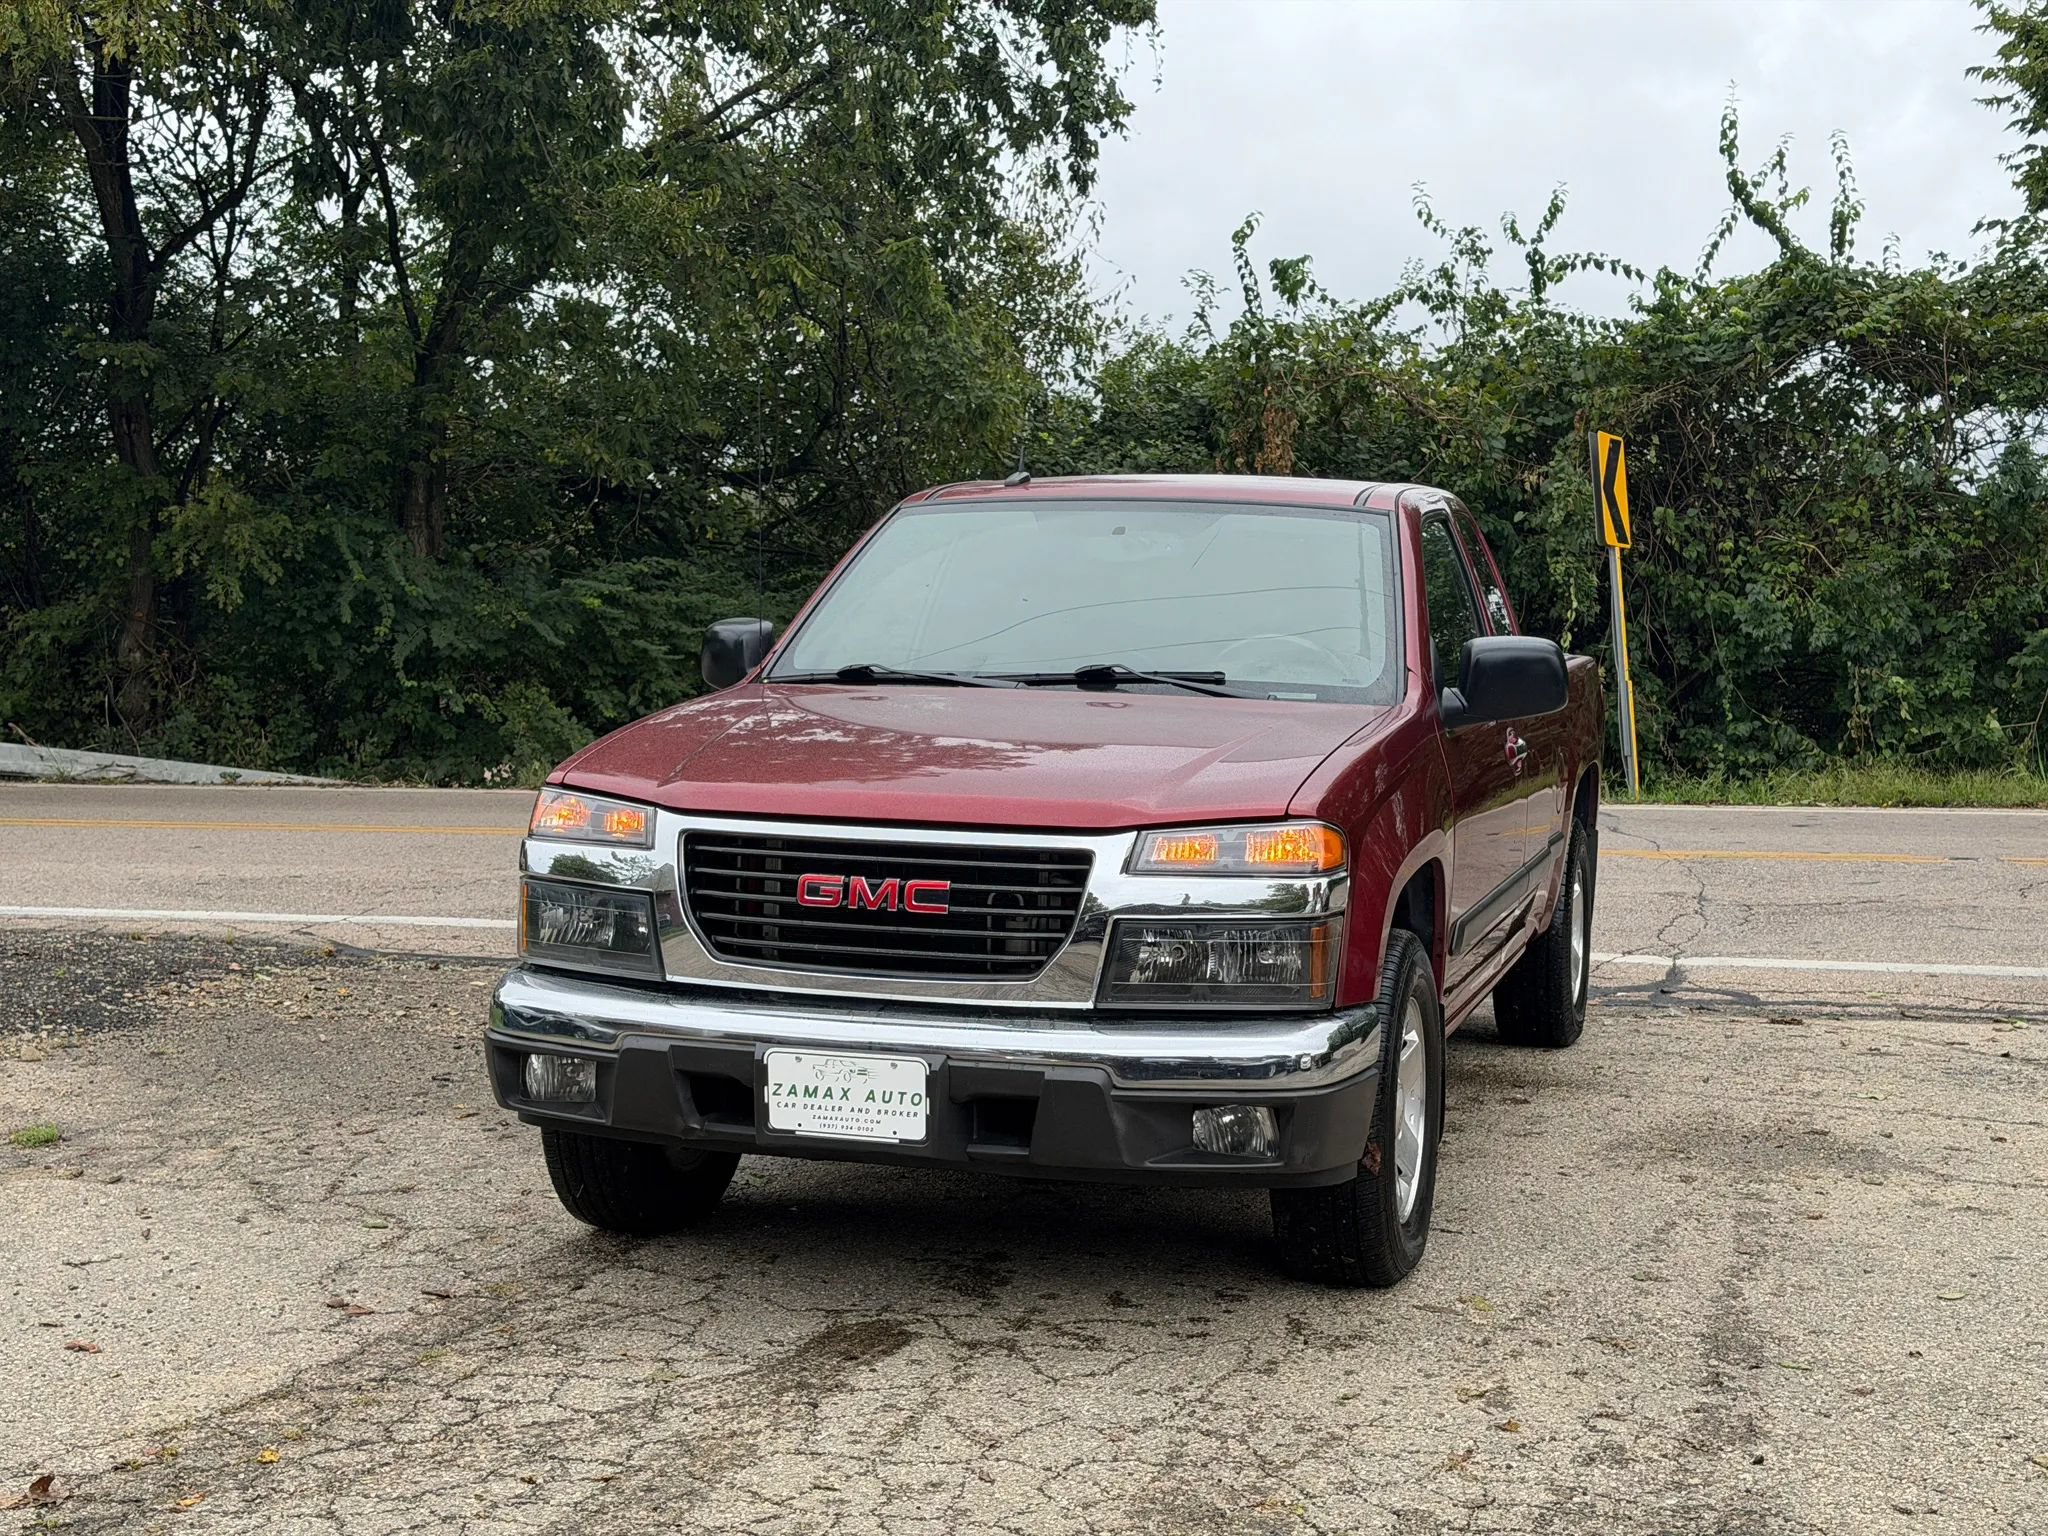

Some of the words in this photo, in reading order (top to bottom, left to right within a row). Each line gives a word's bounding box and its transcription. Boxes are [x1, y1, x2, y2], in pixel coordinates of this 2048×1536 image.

[797, 873, 951, 915] GMC
[772, 1083, 851, 1101] ZAMAX
[865, 1089, 923, 1106] AUTO
[777, 1101, 797, 1109] CAR
[803, 1103, 843, 1112] DEALER
[850, 1107, 870, 1115] AND
[877, 1109, 919, 1118] BROKER
[812, 1115, 882, 1124] ZAMAXAUTO.COM
